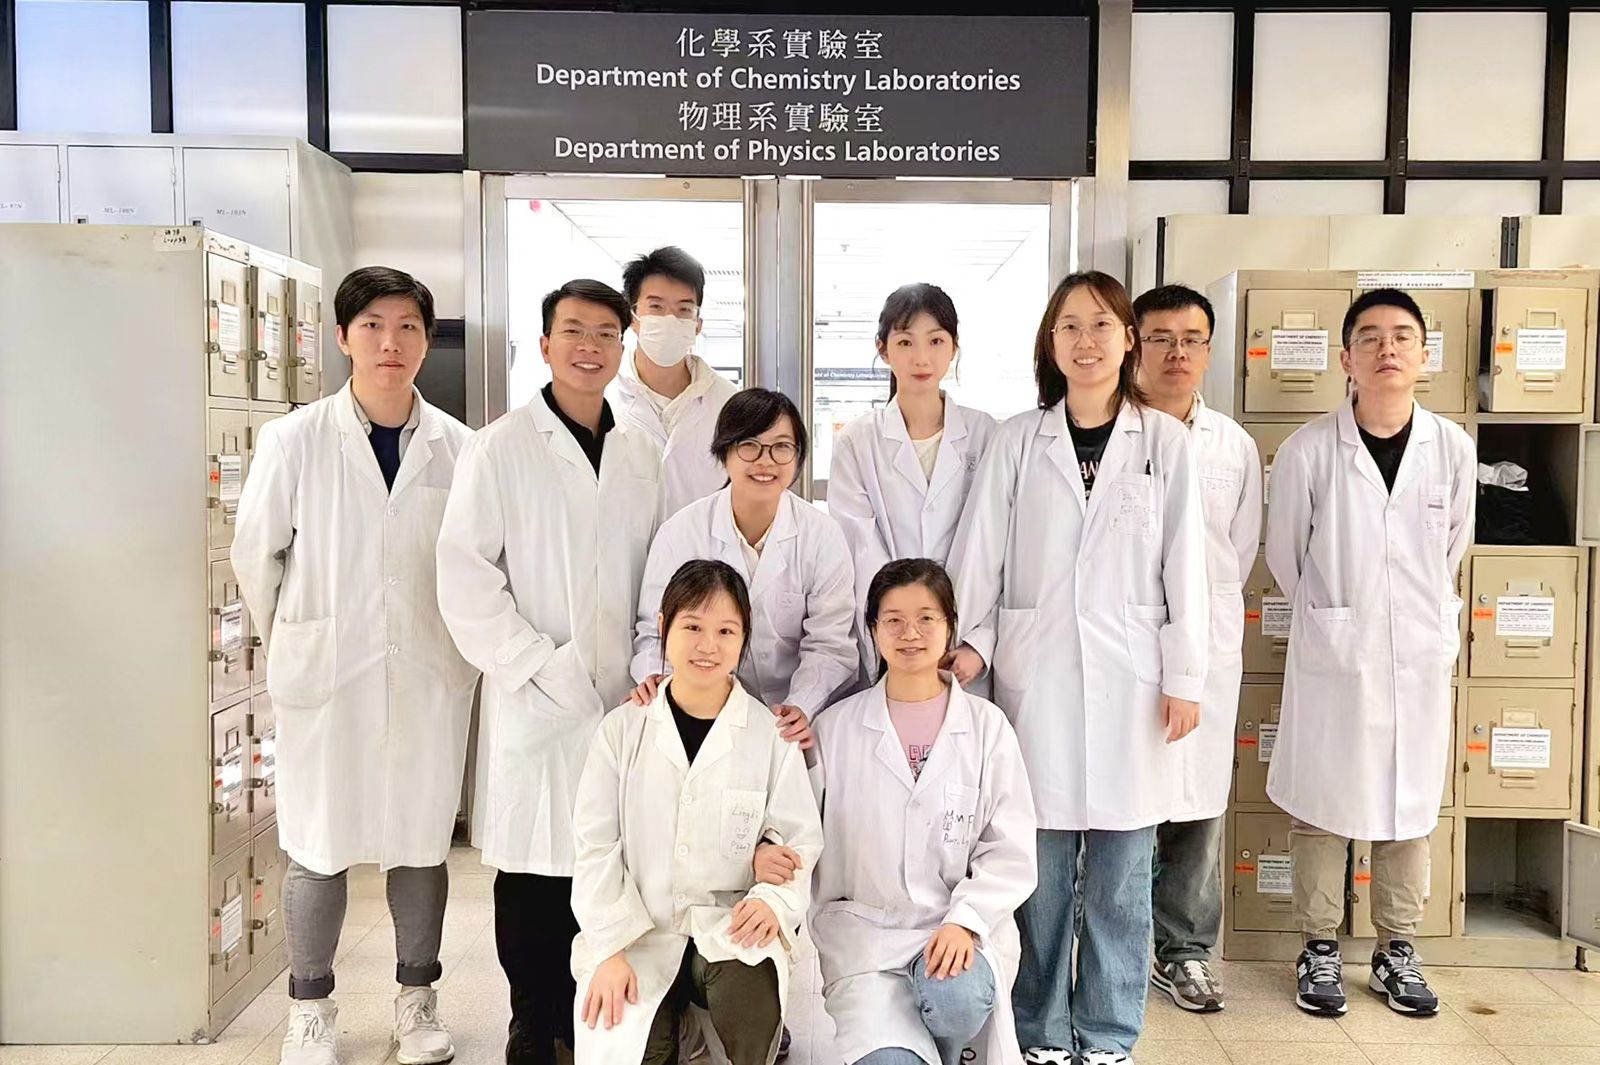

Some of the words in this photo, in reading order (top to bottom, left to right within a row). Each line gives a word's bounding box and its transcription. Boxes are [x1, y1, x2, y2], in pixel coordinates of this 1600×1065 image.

[676, 27, 883, 59] 化學系實驗室
[537, 63, 688, 90] Department
[696, 67, 722, 88] of
[730, 67, 856, 95] Chemistry
[865, 68, 1021, 90] Laboratories
[678, 101, 884, 132] 物理系實驗室
[555, 136, 705, 163] Department
[713, 138, 740, 160] of
[749, 138, 836, 166] Physics
[845, 140, 1000, 161] Laboratories
